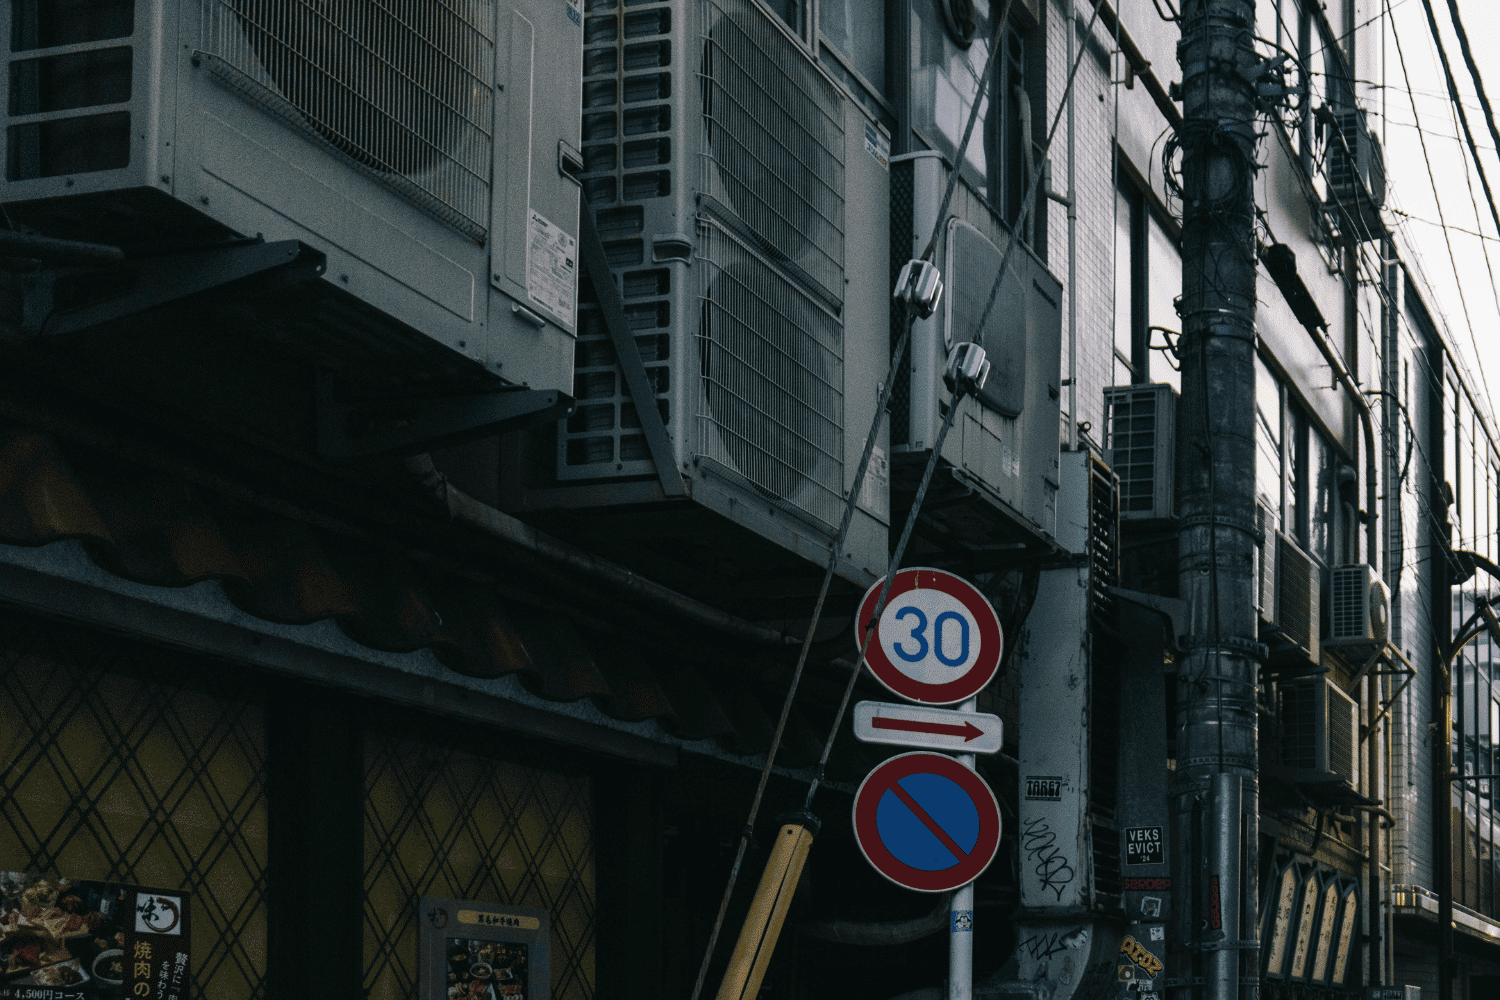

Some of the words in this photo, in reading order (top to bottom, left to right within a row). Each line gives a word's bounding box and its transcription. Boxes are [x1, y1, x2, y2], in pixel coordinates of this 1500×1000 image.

[893, 606, 970, 667] 30
[1129, 829, 1159, 842] VEKS
[1128, 842, 1160, 854] EVICT
[133, 940, 152, 997] 焼肉の
[14, 989, 85, 1000] 4,500円コース
